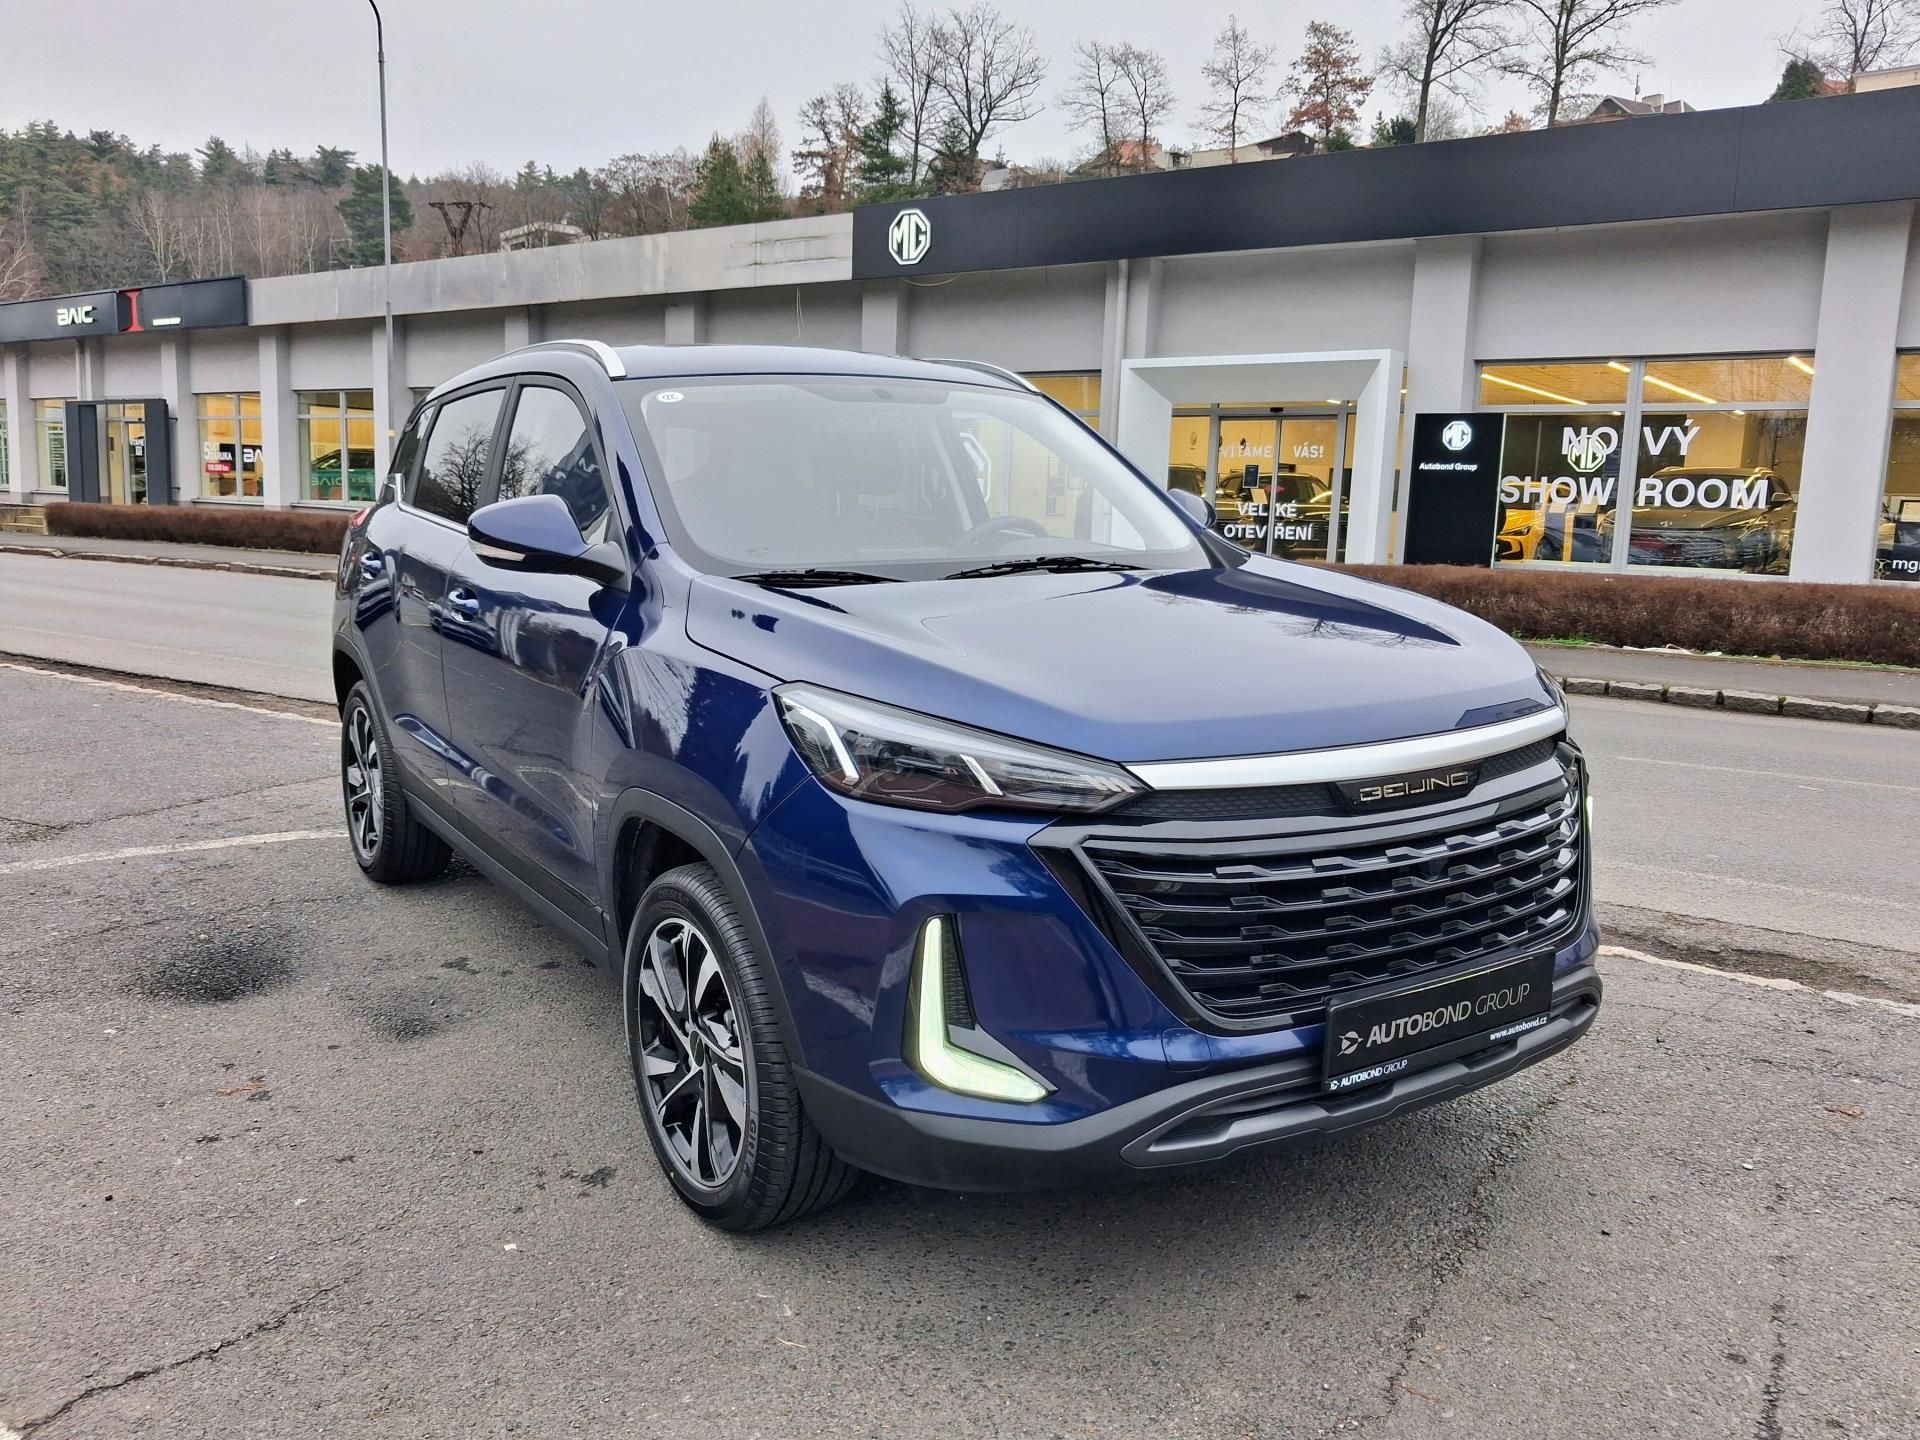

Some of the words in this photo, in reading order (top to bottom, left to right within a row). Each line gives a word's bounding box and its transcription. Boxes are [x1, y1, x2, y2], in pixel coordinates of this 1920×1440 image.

[889, 208, 931, 265] MG
[56, 305, 93, 326] BAIC
[1442, 421, 1472, 450] MG
[1293, 441, 1324, 458] VÁS!
[1419, 462, 1454, 471] Autobond
[1454, 463, 1478, 472] Group
[1892, 559, 1920, 574] mg
[1359, 771, 1468, 801] BEIJING
[1366, 1000, 1471, 1048] AUTOBOND
[1475, 983, 1530, 1016] GROUP
[1490, 1016, 1547, 1041] www.autobond.cz
[1340, 1067, 1383, 1088] AUTOBOND
[1383, 1059, 1408, 1074] GROUP
